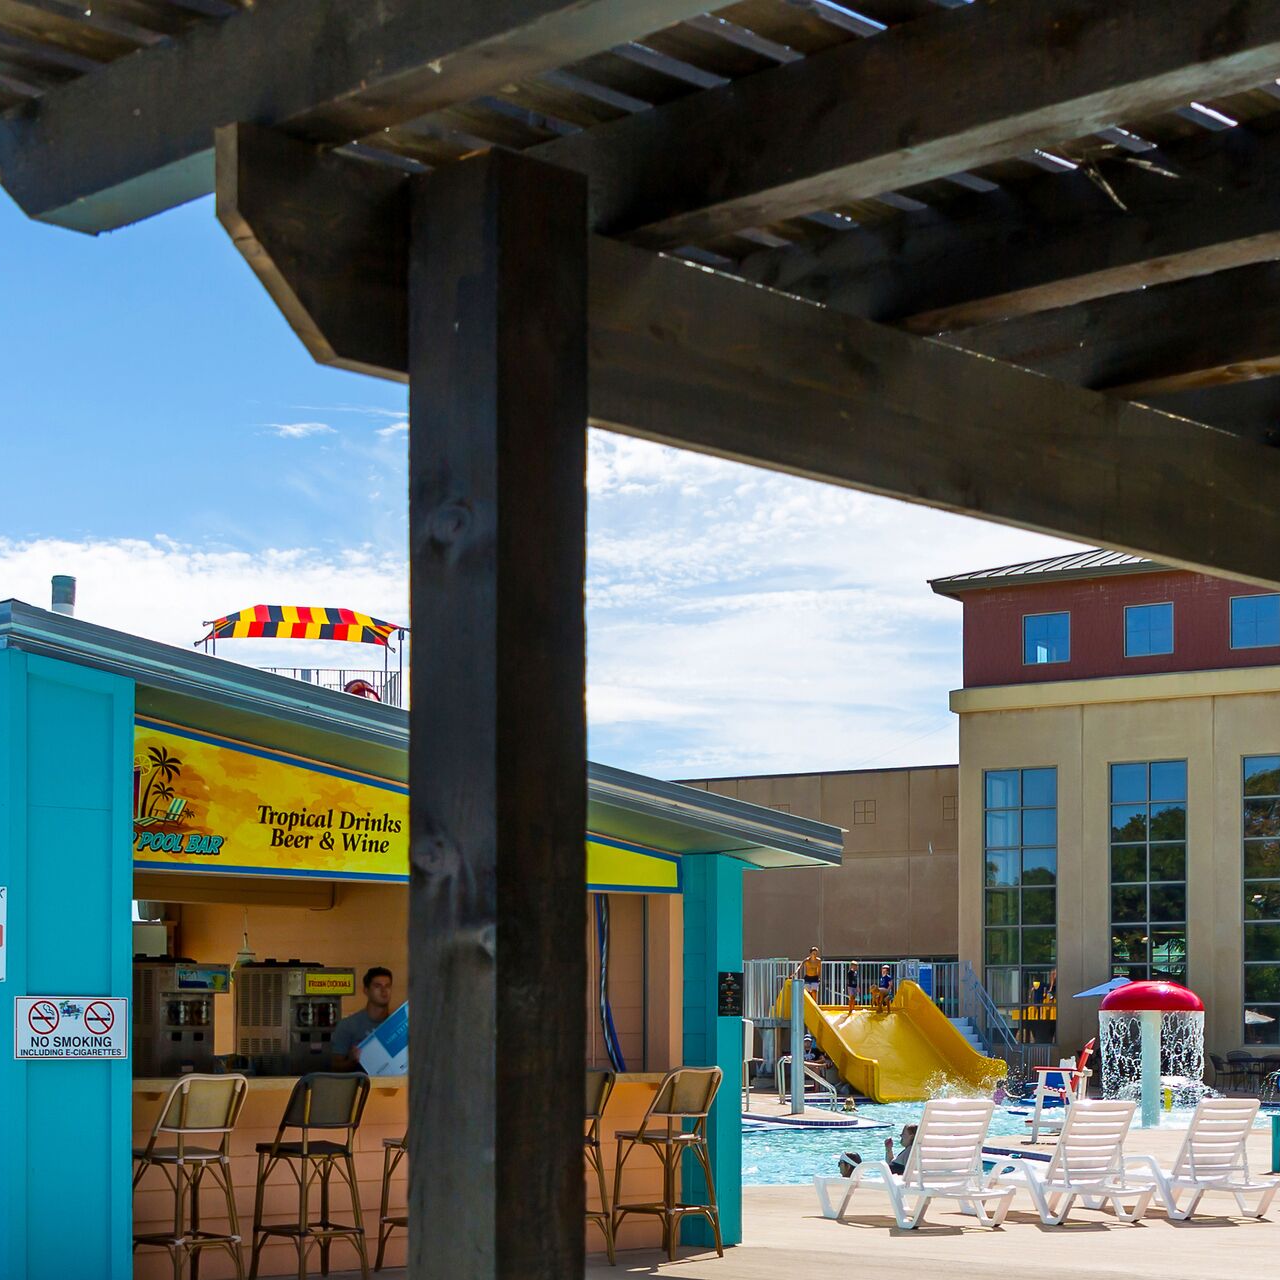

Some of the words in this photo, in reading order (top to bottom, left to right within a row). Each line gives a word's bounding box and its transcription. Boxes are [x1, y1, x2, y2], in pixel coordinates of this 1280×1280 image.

[257, 805, 333, 830] Tropical
[339, 811, 402, 834] Drinks
[137, 831, 182, 852] POOL
[185, 833, 223, 855] BAR
[270, 828, 314, 850] Beer
[319, 831, 335, 851] &
[341, 832, 390, 854] Wine
[20, 1048, 64, 1056] INCLUDING
[31, 1036, 50, 1048] NO
[53, 1036, 112, 1048] SMOKING
